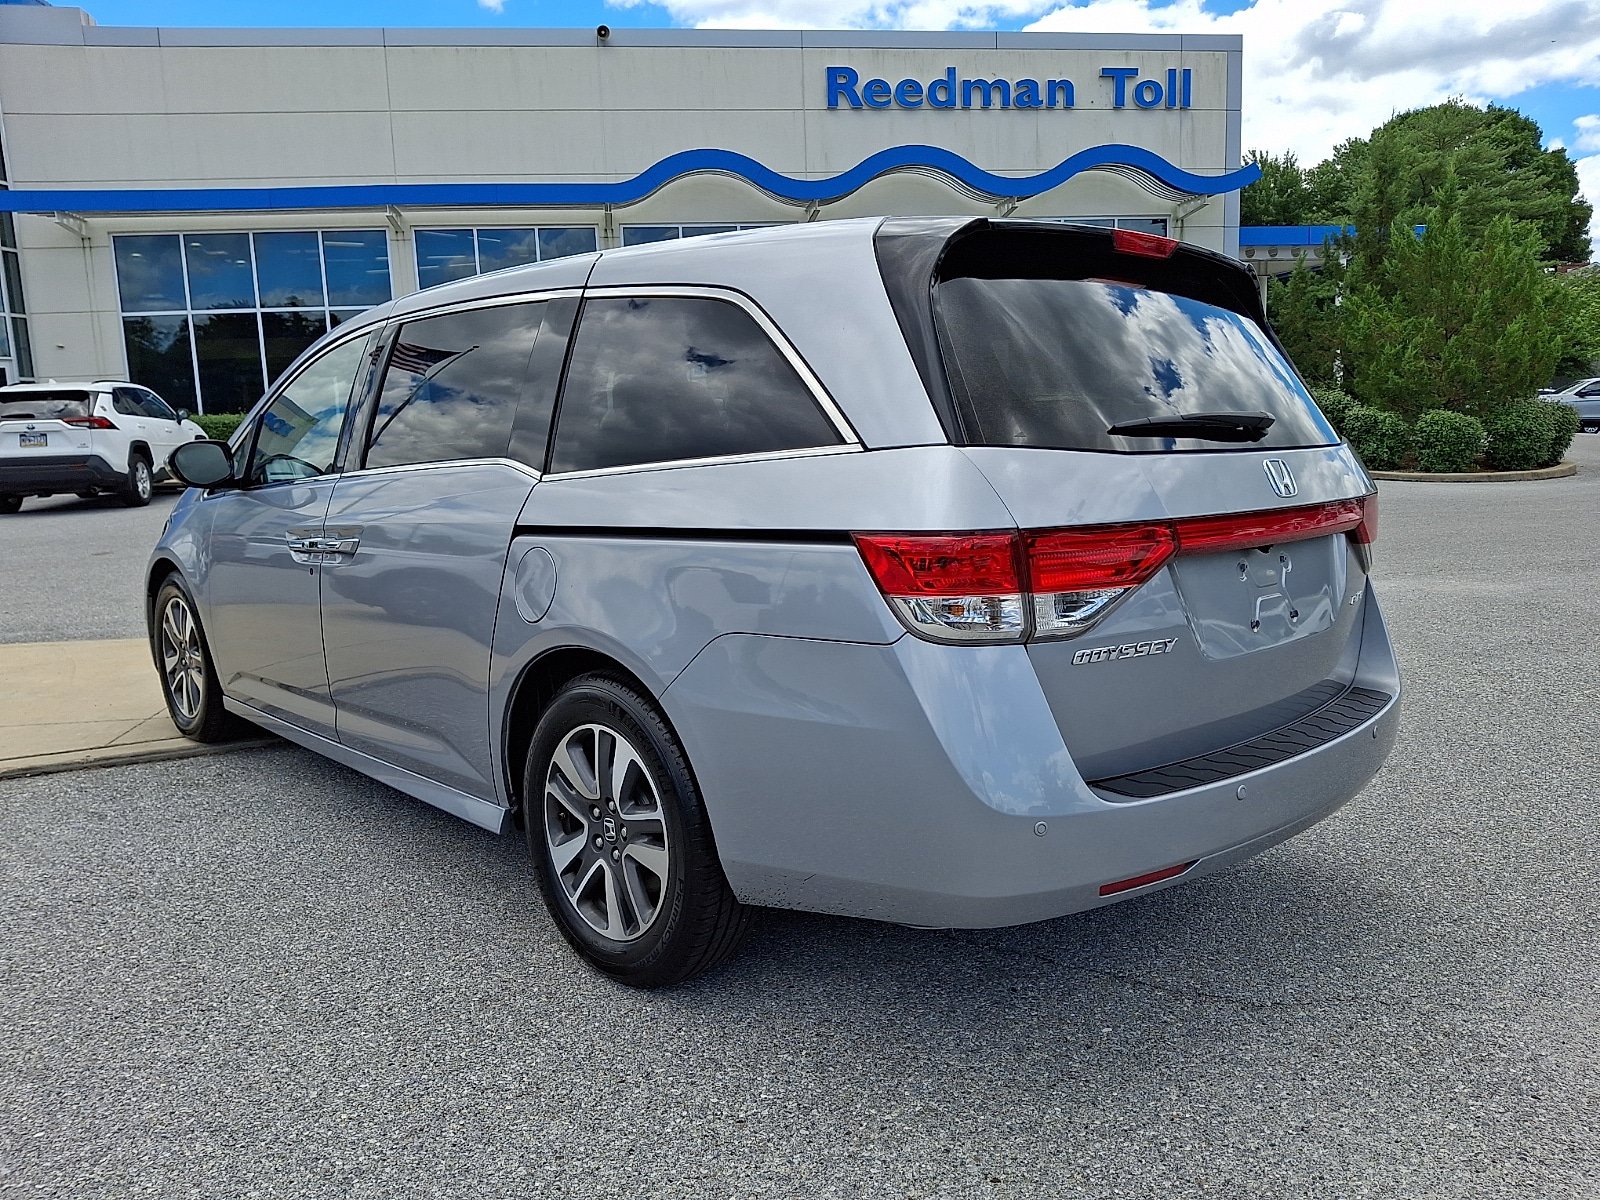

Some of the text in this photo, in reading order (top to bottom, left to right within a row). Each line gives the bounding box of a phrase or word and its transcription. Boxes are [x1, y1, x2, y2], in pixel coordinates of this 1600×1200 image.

[825, 66, 1192, 109] Reedman Toll
[1071, 638, 1178, 665] ODYSSEY
